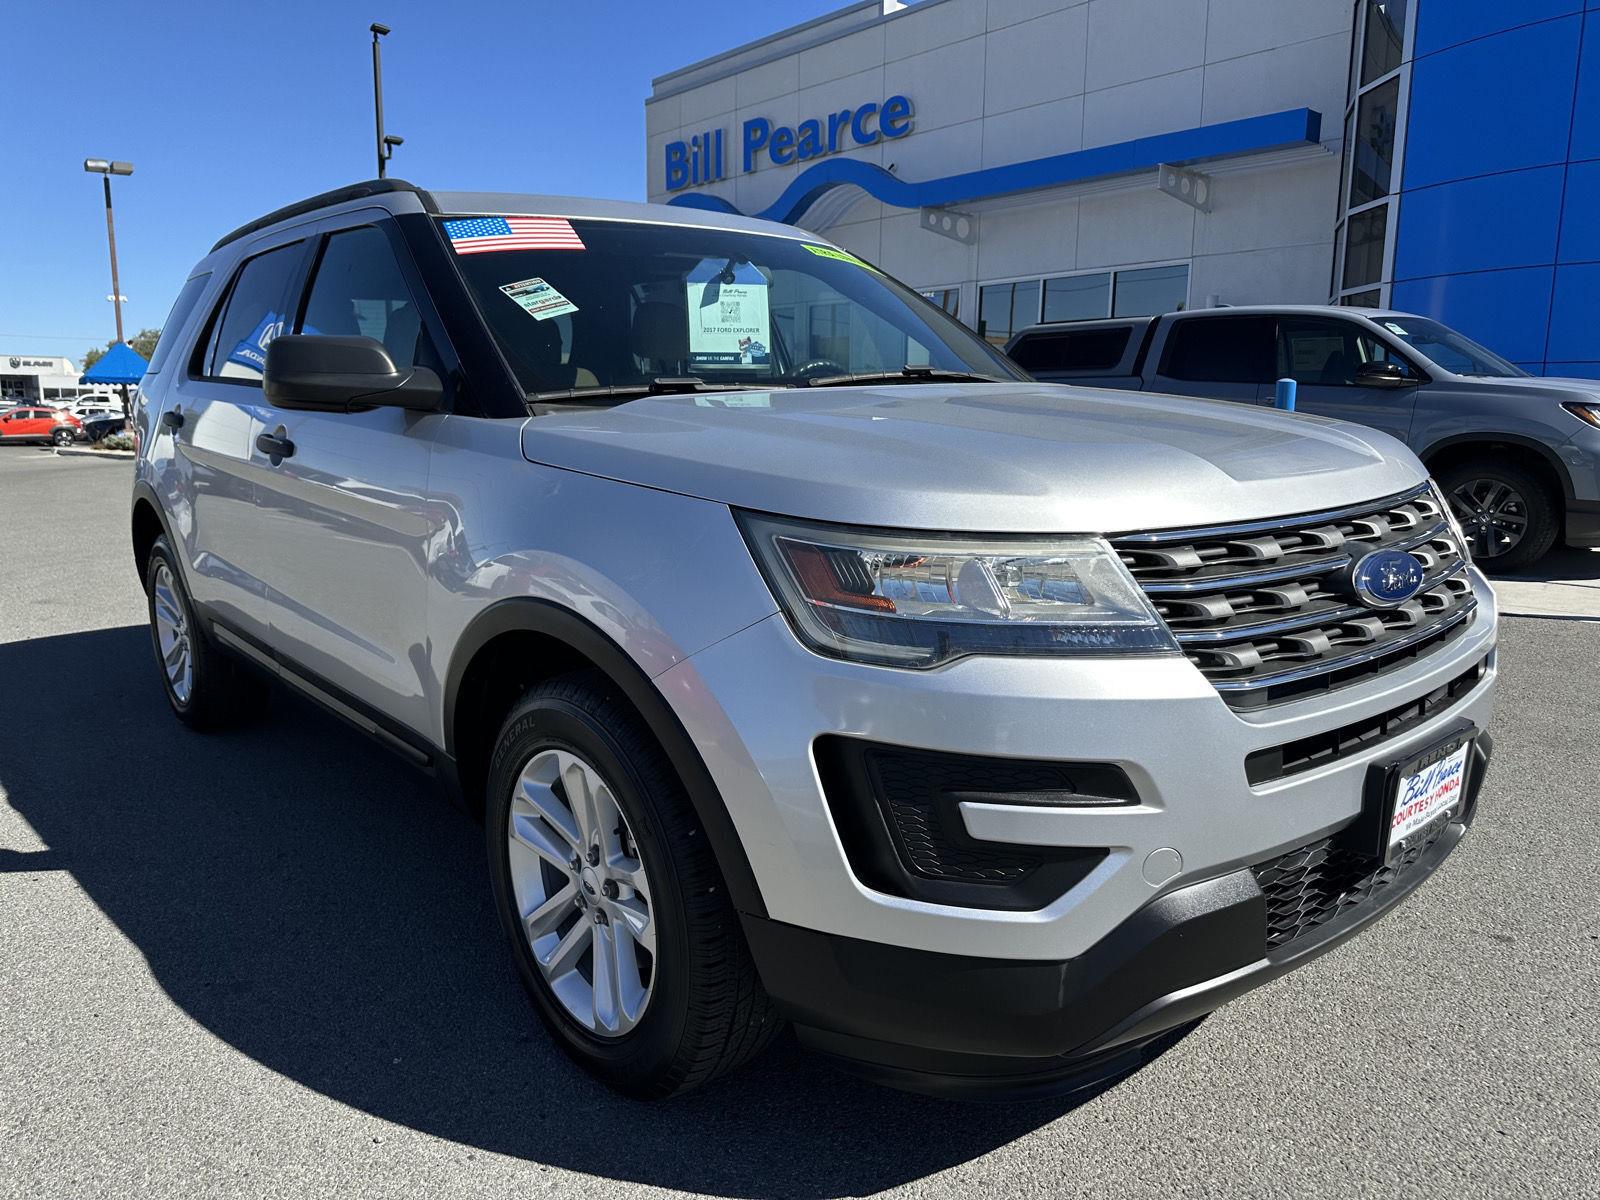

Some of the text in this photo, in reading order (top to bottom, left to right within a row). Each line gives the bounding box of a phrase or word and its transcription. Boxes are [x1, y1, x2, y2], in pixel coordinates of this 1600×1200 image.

[665, 95, 913, 192] Bill Pearce
[495, 715, 536, 769] GENERAL
[1391, 793, 1434, 829] COURTESY
[1435, 776, 1460, 798] HONDA
[1401, 768, 1435, 806] Bill
